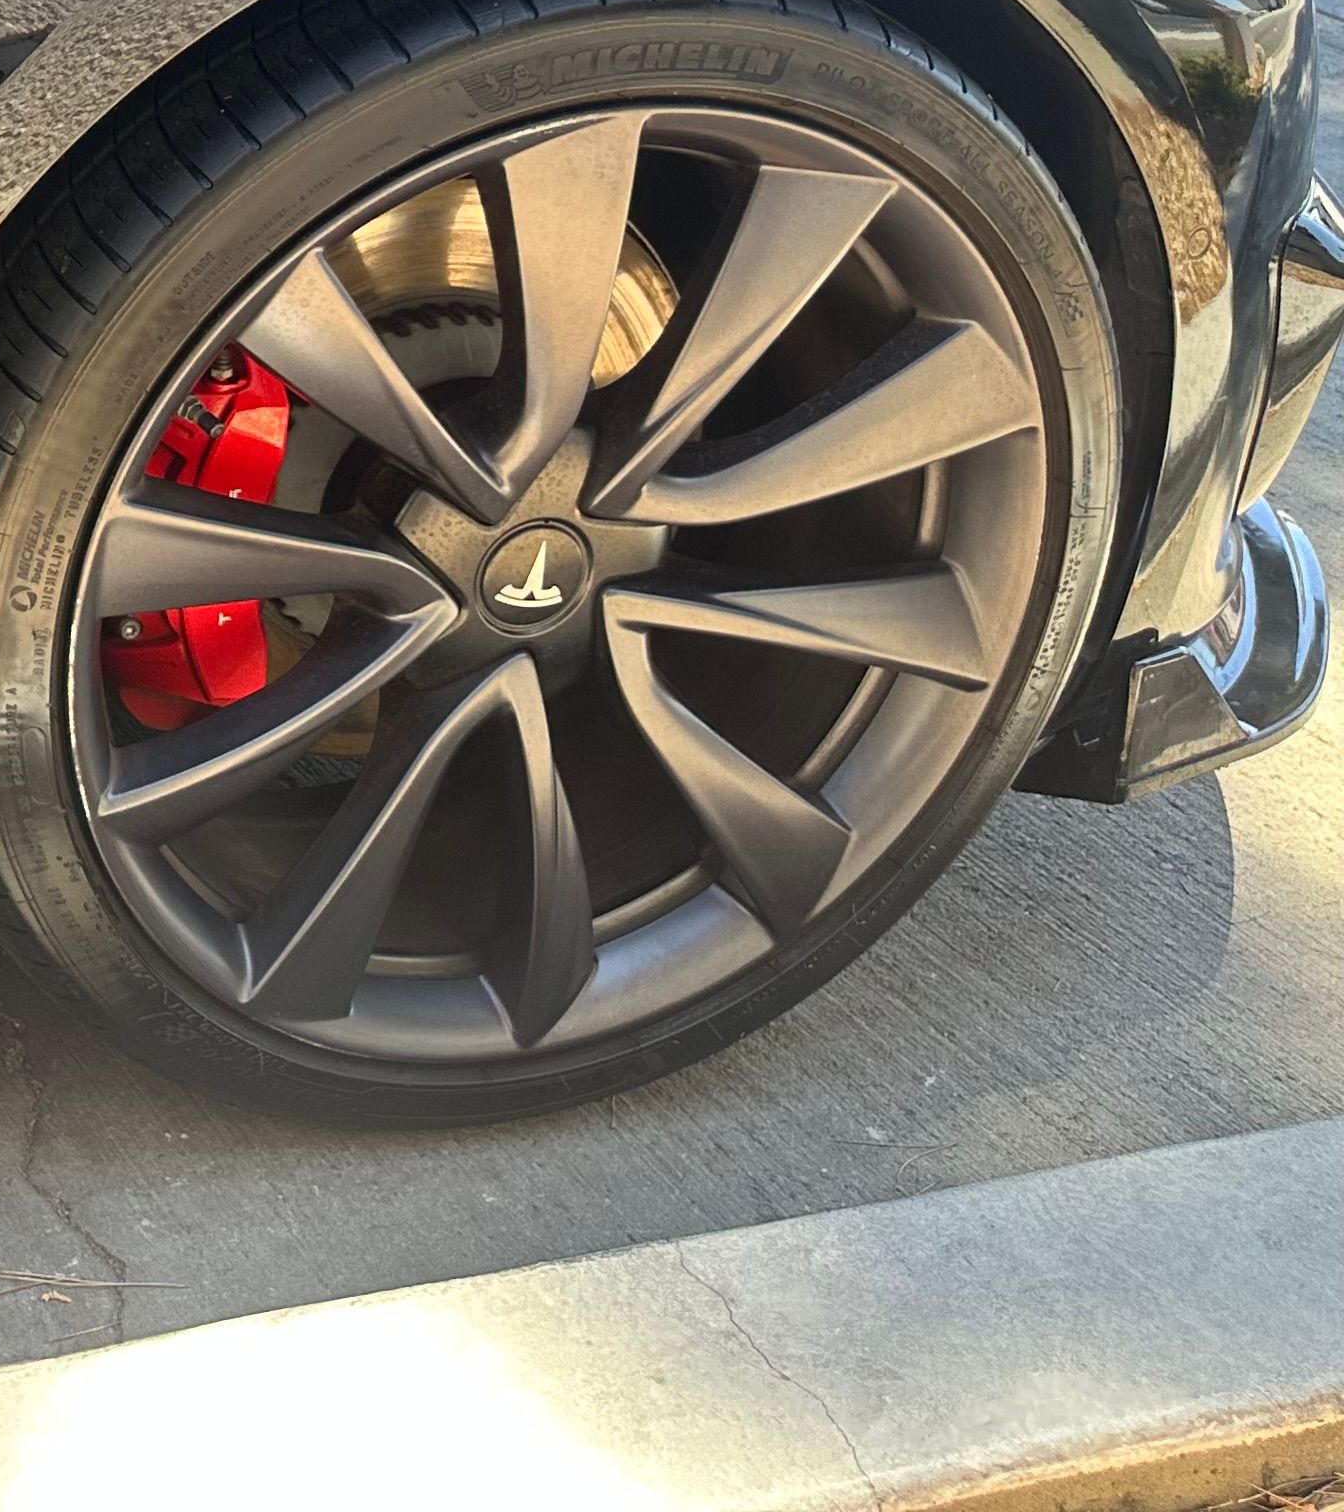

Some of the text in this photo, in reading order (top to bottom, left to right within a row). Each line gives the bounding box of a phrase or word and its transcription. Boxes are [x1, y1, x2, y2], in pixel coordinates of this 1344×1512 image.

[548, 41, 782, 87] MICHELIN
[960, 143, 994, 183] ALL
[997, 179, 1053, 261] SEASON
[173, 250, 217, 296] OUTSIDE
[64, 447, 105, 519] TUBELESS
[16, 510, 46, 581] MICHELIN
[30, 488, 69, 585] Total Performance
